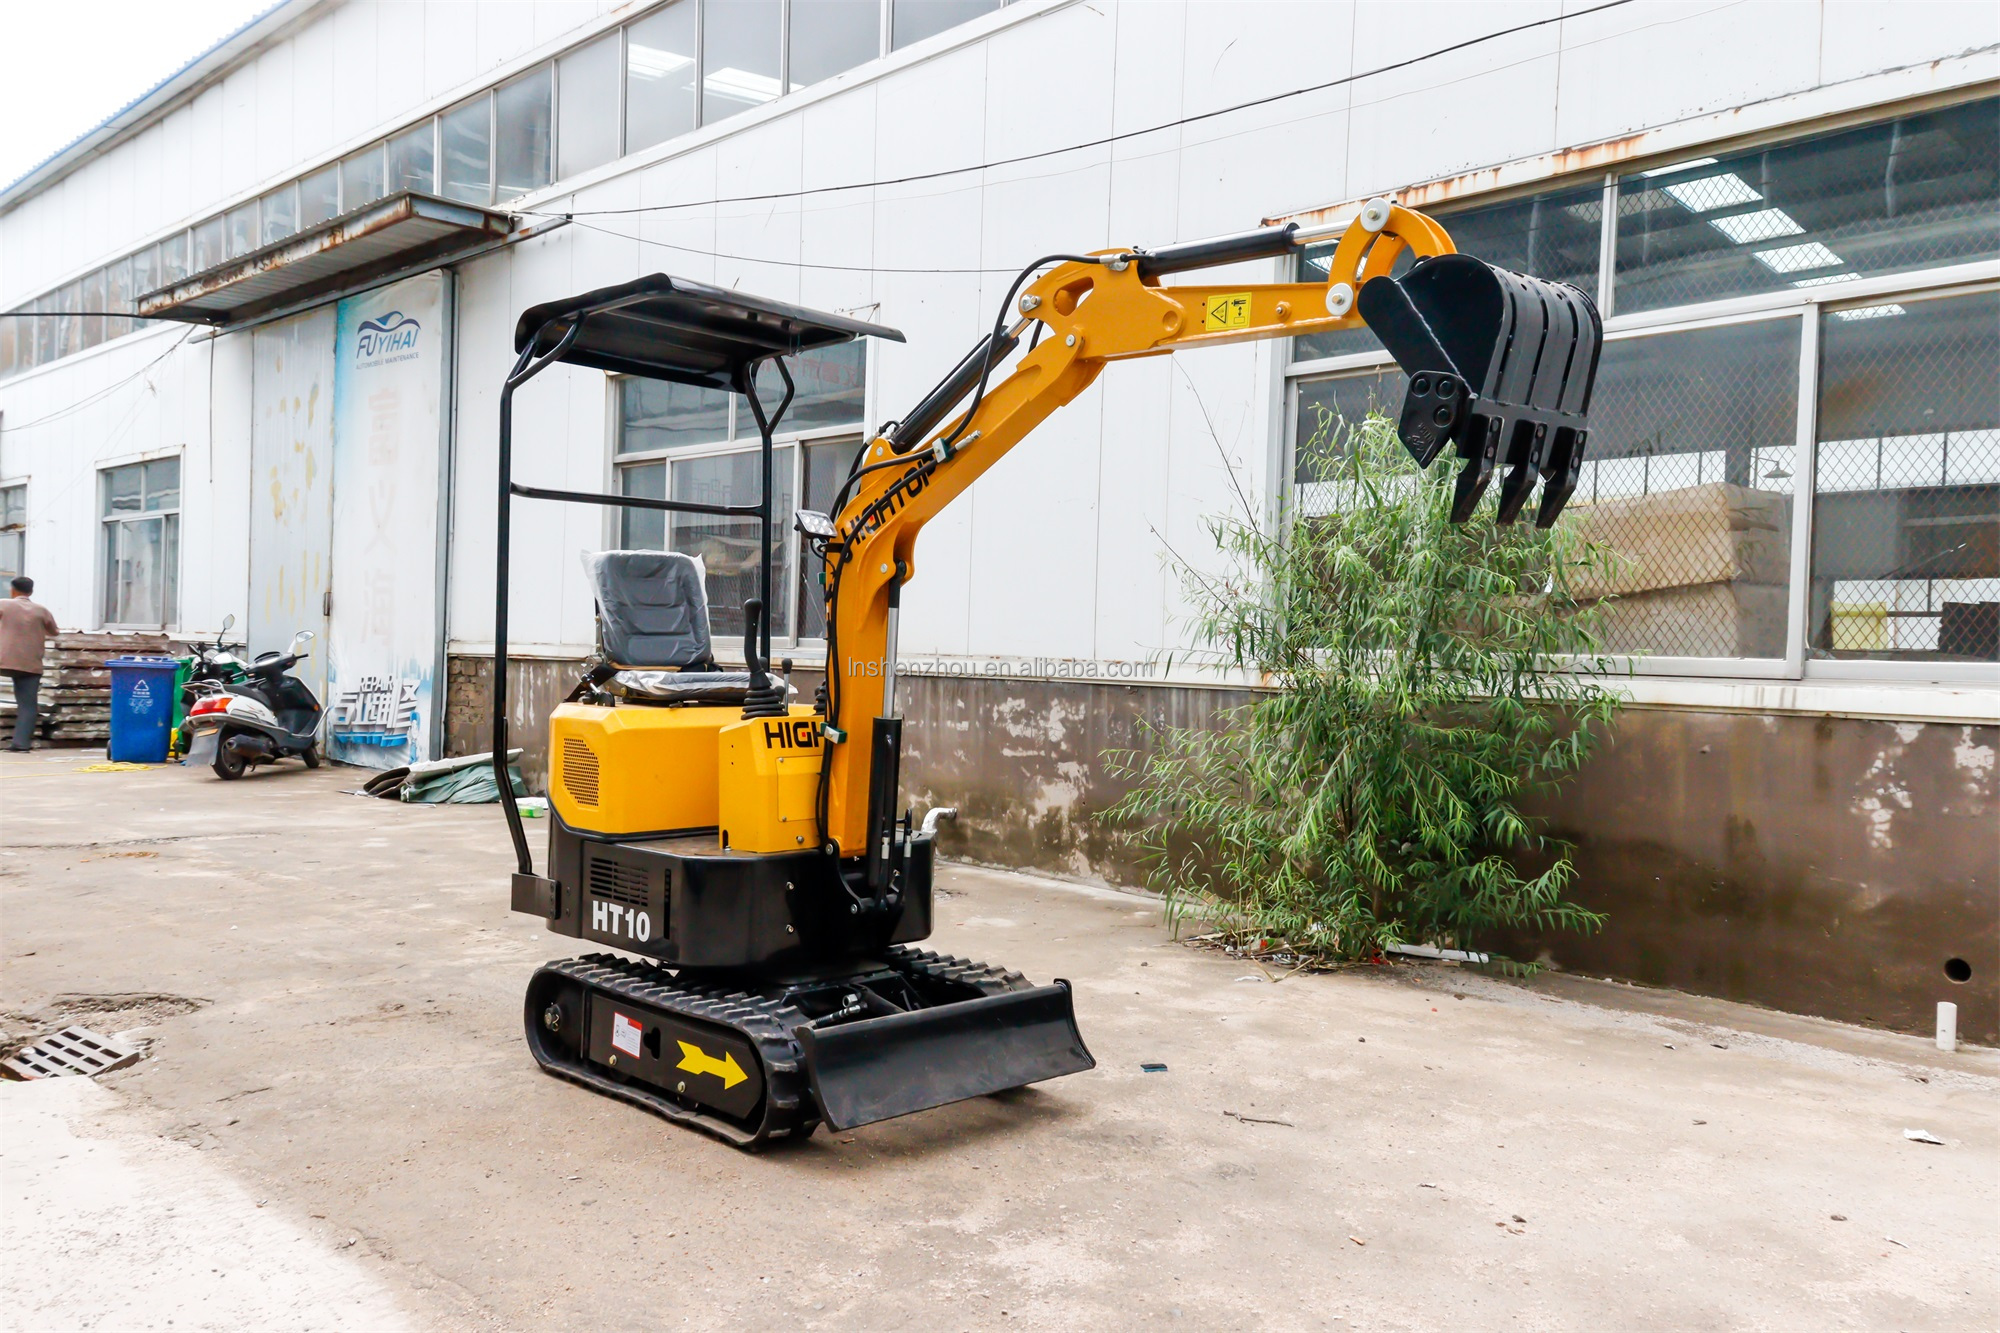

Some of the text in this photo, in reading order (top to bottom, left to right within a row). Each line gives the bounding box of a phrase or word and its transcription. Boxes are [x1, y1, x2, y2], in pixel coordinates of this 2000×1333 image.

[356, 328, 419, 359] FUYIHAI
[385, 352, 419, 364] MAINTENANCE
[360, 675, 394, 692] REPAIR
[592, 900, 651, 943] HT10
